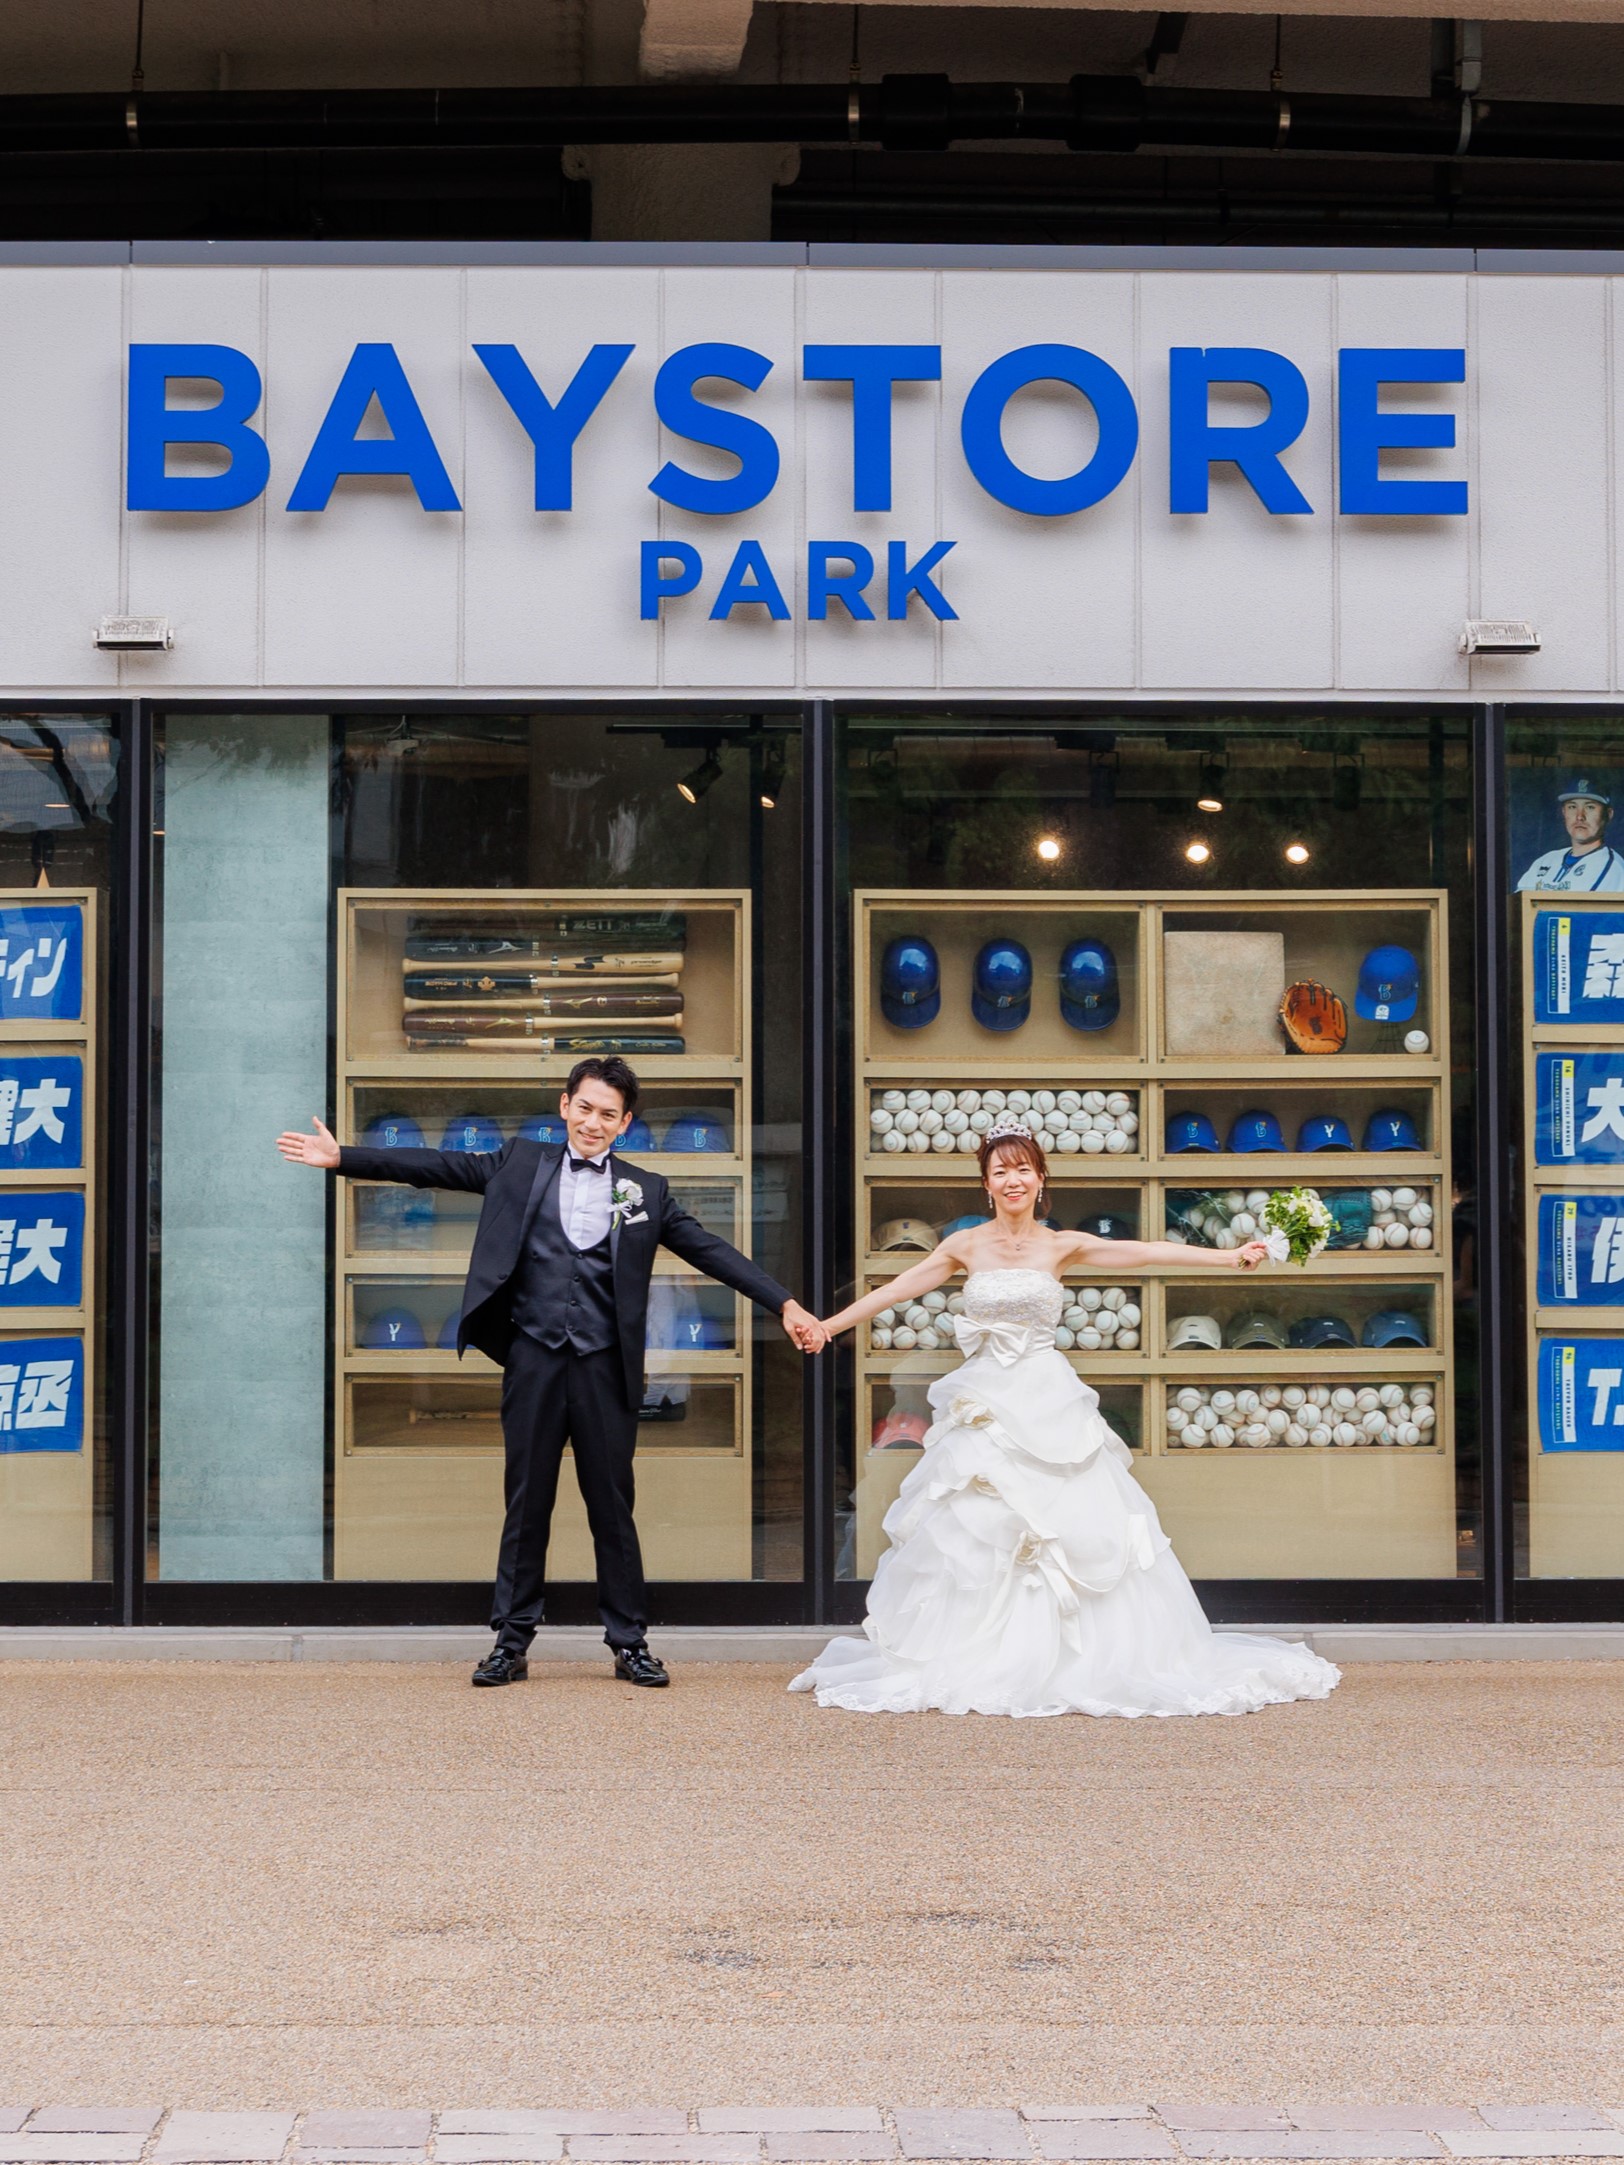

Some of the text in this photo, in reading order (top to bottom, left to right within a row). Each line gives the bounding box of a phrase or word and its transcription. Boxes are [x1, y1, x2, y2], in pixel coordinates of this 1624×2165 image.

[127, 343, 1468, 516] BAYSTORE
[640, 540, 959, 621] PARK
[573, 919, 614, 930] ZETT
[0, 937, 67, 998] ィン
[1378, 984, 1392, 1001] B
[384, 1127, 398, 1146] B
[463, 1127, 478, 1146] B
[1324, 1124, 1335, 1138] Y
[1390, 1121, 1401, 1136] Y
[389, 1323, 401, 1341] Y
[689, 1324, 702, 1342] Y
